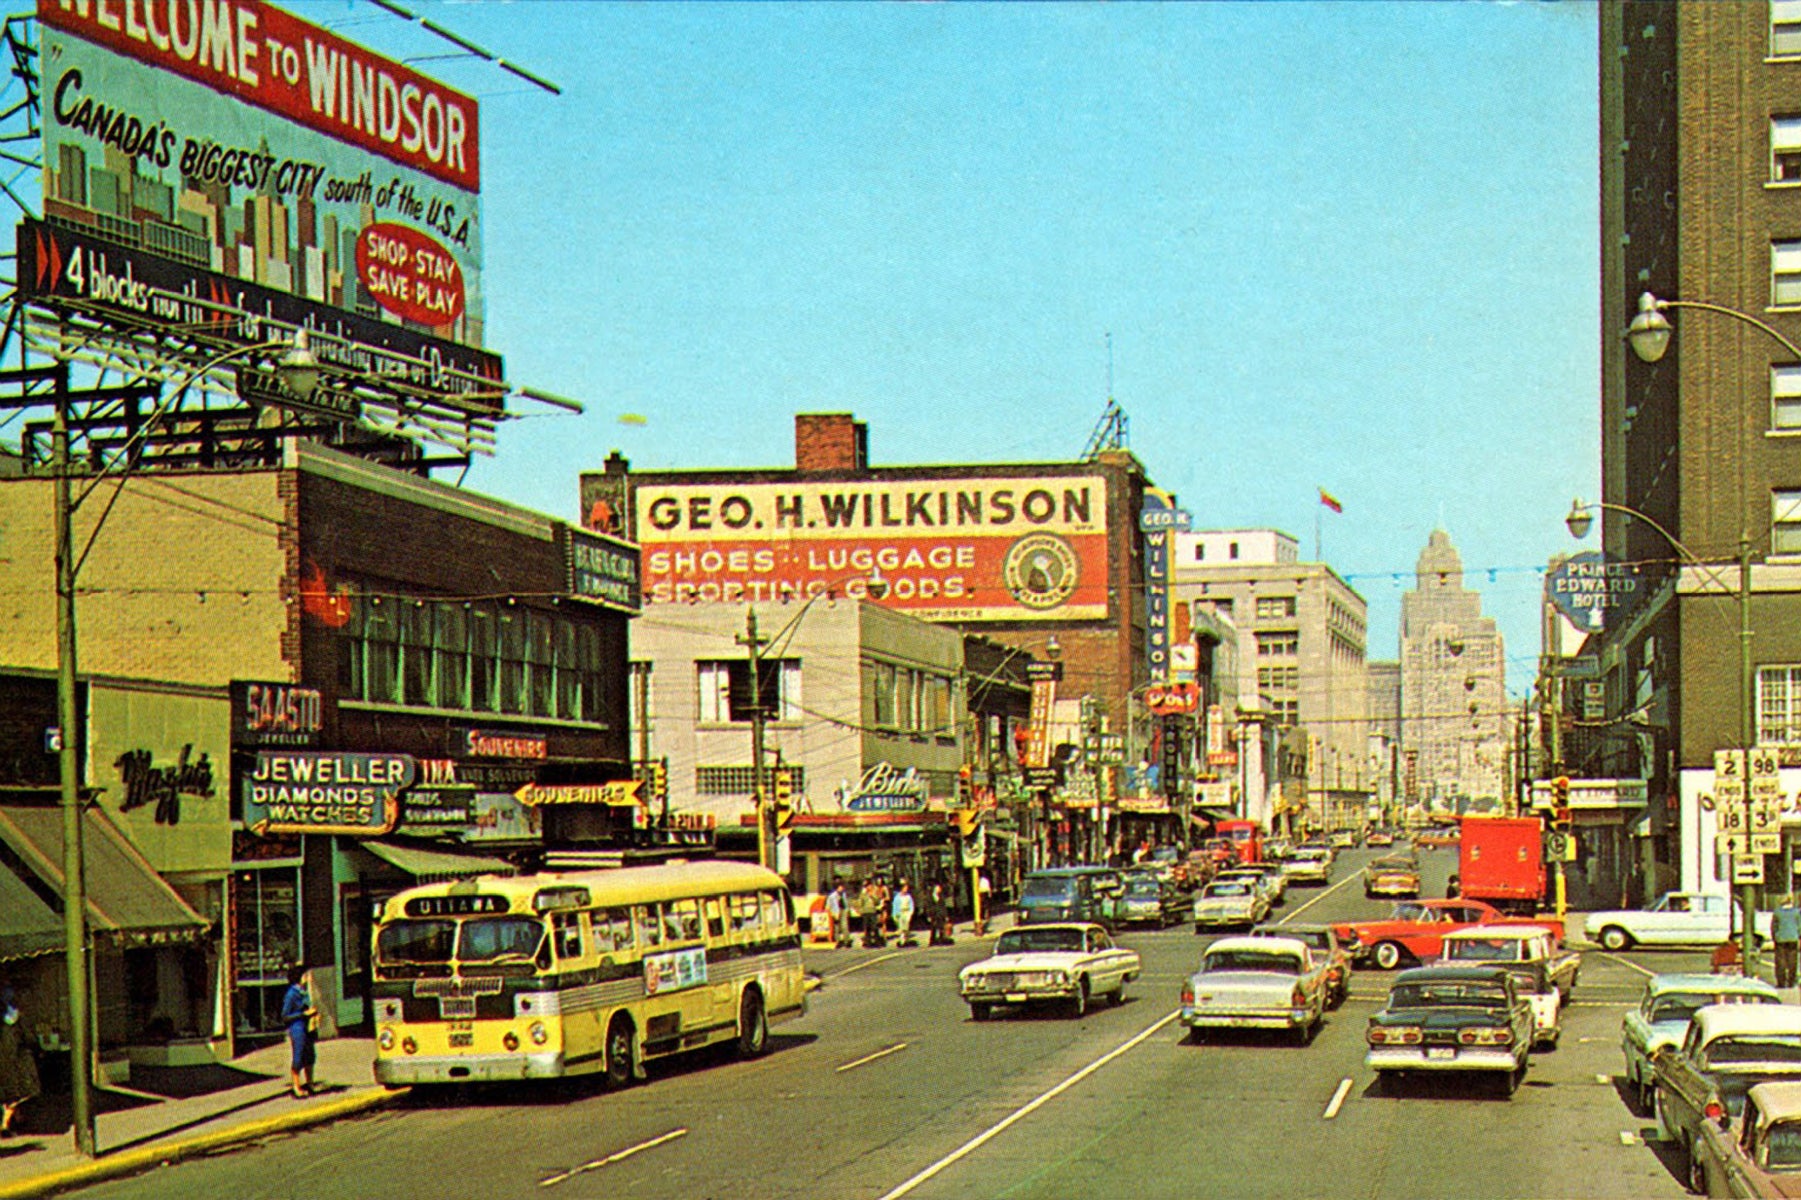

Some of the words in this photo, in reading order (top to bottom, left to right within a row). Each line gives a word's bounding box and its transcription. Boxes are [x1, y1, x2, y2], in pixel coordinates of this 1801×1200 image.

[58, 0, 260, 87] LCOME
[267, 38, 301, 86] TO
[305, 37, 467, 174] WINDSOR
[180, 138, 275, 189] BIGGEST
[276, 158, 324, 198] CITY
[325, 172, 373, 206] south
[376, 176, 400, 208] of
[399, 186, 424, 217] the
[367, 232, 408, 268] SHOP
[416, 249, 456, 283] STAY
[65, 245, 84, 294] 4
[89, 249, 147, 312] blocks
[367, 266, 410, 302] SAVE
[416, 281, 456, 317] PLAY
[648, 496, 763, 531] GEO.
[776, 495, 815, 527] H.
[820, 487, 1093, 527] WILKINSON
[649, 548, 775, 573] SHOES
[808, 545, 977, 571] LUGGAGE
[1567, 562, 1625, 577] PRINCE
[651, 580, 829, 600] SPORTING
[1556, 578, 1636, 594] EDWARD
[1147, 533, 1167, 681] WILKINSON
[1572, 592, 1621, 608] HOTEL
[467, 729, 547, 759] SOUVENIRS
[252, 756, 405, 786] JEWELLER
[1723, 760, 1737, 775] 2
[1753, 757, 1775, 775] 98
[251, 786, 375, 805] DIAMONDS
[523, 786, 626, 804] SOUVENIRS
[268, 804, 372, 824] WATCHES
[1723, 812, 1740, 828] 18
